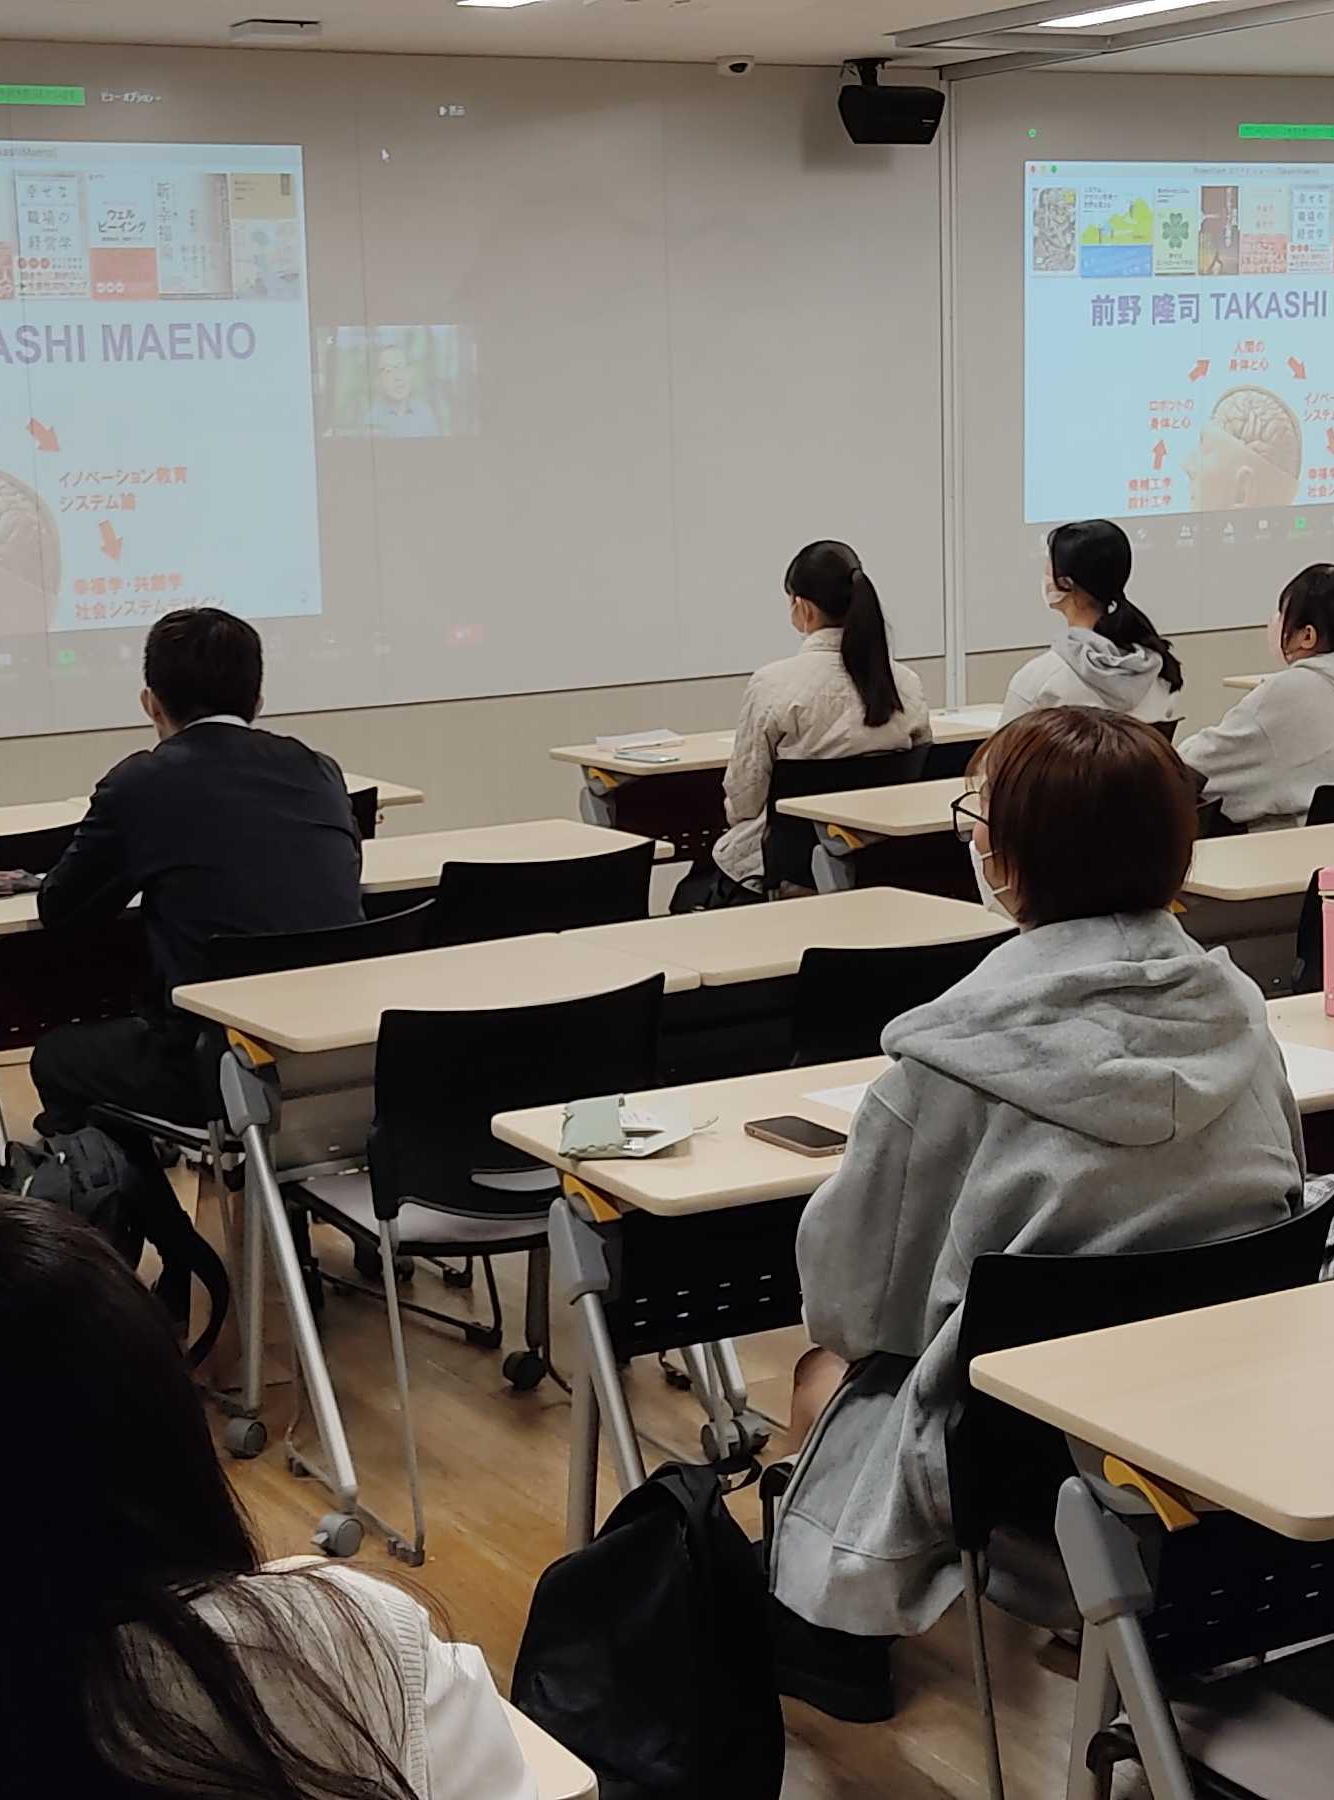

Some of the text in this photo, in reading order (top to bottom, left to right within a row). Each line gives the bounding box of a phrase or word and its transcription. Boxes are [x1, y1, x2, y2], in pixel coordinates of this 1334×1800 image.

[1091, 295, 1141, 327] 前野
[1151, 293, 1200, 325] 隆司
[1210, 290, 1327, 321] TAKASHI
[101, 321, 256, 363] MAENO
[59, 465, 188, 488] イノベーション教育
